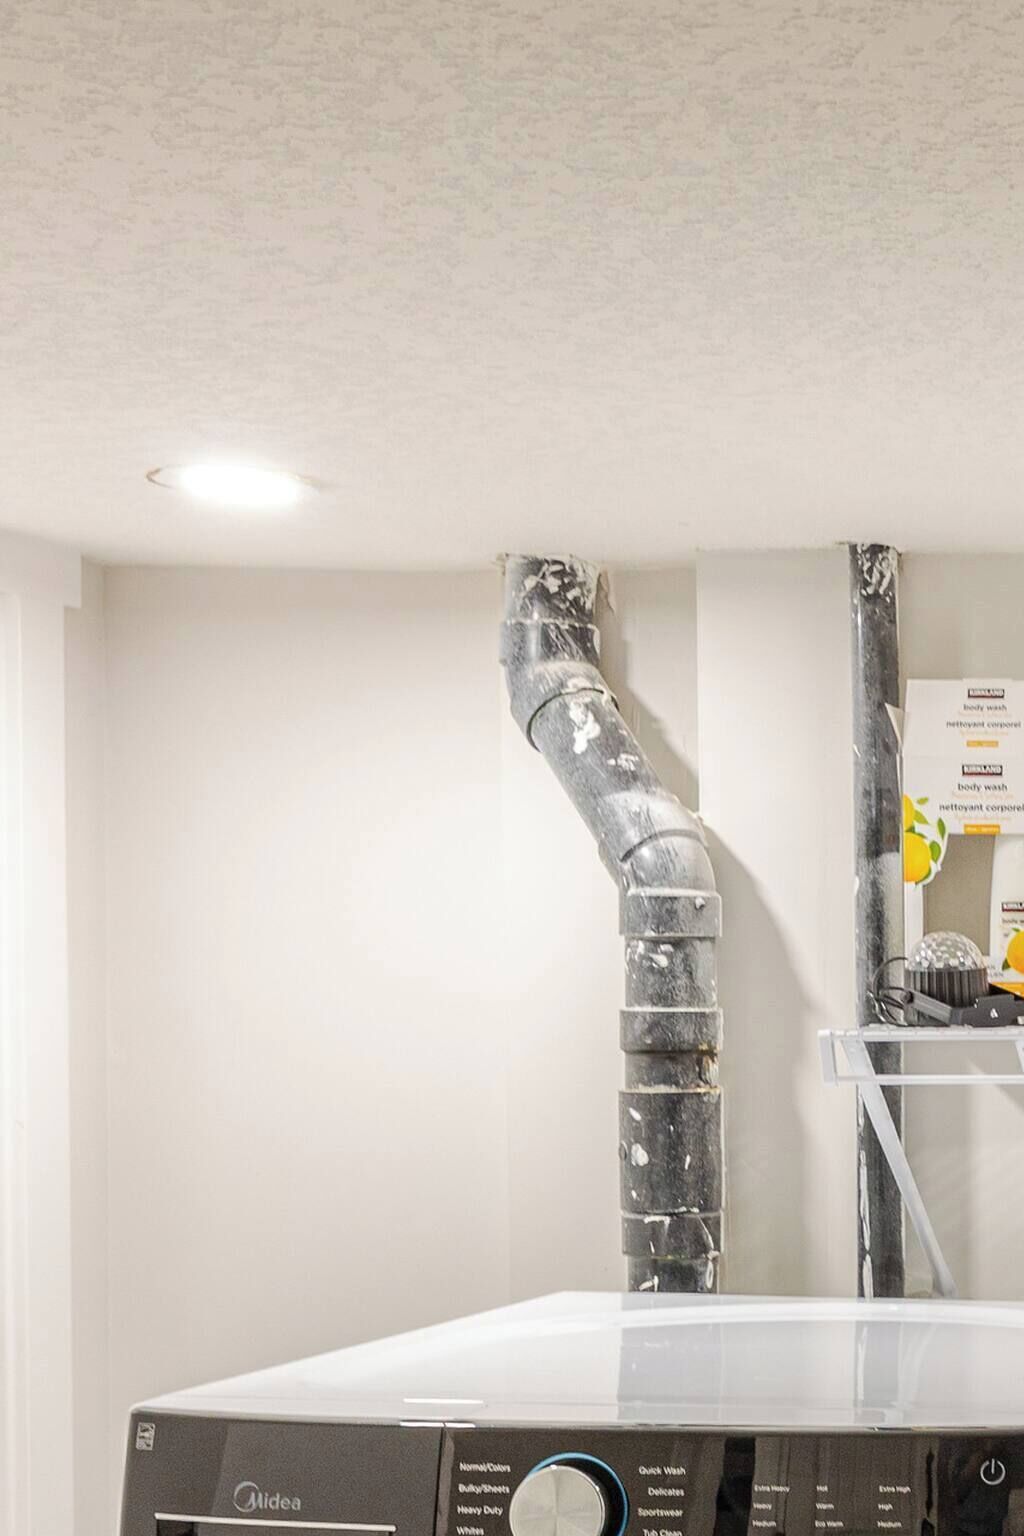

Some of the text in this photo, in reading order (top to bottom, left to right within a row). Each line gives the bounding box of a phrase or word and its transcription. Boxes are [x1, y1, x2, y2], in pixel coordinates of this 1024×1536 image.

[969, 688, 1004, 697] KIRKLAND
[964, 704, 984, 712] body
[946, 721, 984, 729] nettoyant
[963, 765, 1002, 774] KIRKLAND
[958, 783, 982, 792] body
[940, 803, 1024, 812] nettoyant corporel
[460, 1462, 511, 1472] Normal/Colors
[638, 1466, 686, 1476] Quick Wash
[458, 1484, 510, 1494] Bulky/Sheets
[648, 1487, 684, 1496] Delicates
[238, 1484, 301, 1512] Midea
[457, 1505, 503, 1516] Heavy Duty
[638, 1507, 683, 1517] Sportswear
[456, 1526, 484, 1536] Whites
